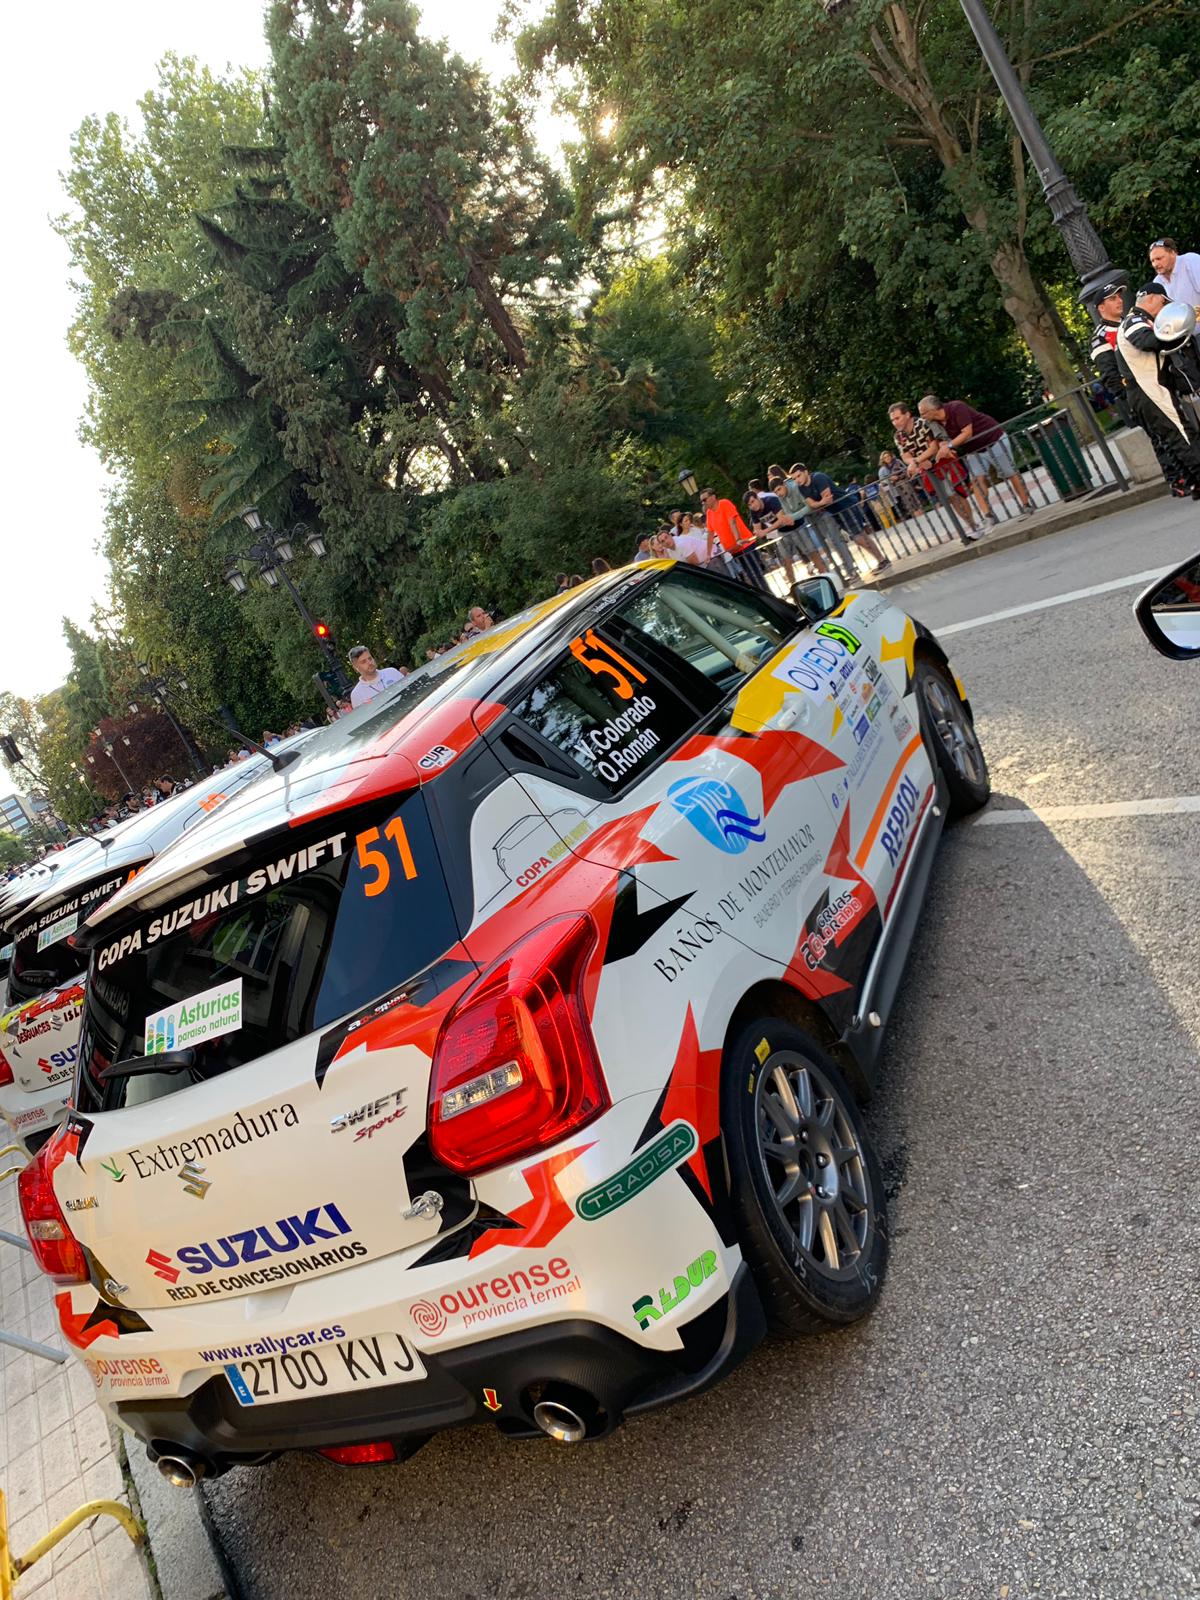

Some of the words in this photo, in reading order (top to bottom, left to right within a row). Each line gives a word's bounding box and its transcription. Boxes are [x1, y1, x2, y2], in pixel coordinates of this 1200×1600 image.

[569, 628, 648, 700] 51
[787, 638, 846, 691] OVIEDO
[815, 622, 862, 656] 51
[597, 728, 661, 782] O.Román
[880, 773, 920, 868] REPSOL
[355, 815, 418, 897] 51
[514, 856, 553, 888] COPA
[39, 898, 79, 928] SUZUKI
[80, 877, 123, 905] SWIFT
[97, 929, 142, 971] COPA
[146, 880, 239, 944] SUZUKI
[245, 831, 347, 894] SWIFT
[652, 911, 722, 983] BAÑOS
[717, 890, 745, 921] DE
[738, 823, 816, 903] MONTEMAYOR
[178, 990, 241, 1029] Asturias
[208, 1010, 241, 1031] natural
[46, 1072, 61, 1084] RED
[60, 1068, 71, 1079] DE
[330, 1086, 409, 1134] SWIFT
[352, 1105, 409, 1143] Sport
[127, 1103, 300, 1180] Extremadura
[586, 1136, 687, 1209] TRADISA
[176, 1201, 353, 1275] SUZUKI
[166, 1286, 198, 1302] RED
[197, 1281, 221, 1296] DE
[218, 1241, 368, 1292] CONCESIONARIOS
[439, 1257, 571, 1314] ourense
[462, 1297, 529, 1329] provincia
[529, 1275, 582, 1305] termal
[96, 1357, 163, 1376] ourense
[198, 1324, 347, 1363] www.rallycar.es
[241, 1350, 329, 1397] 2700
[336, 1333, 415, 1381] KVJ
[109, 1374, 144, 1390] provincia
[143, 1373, 171, 1387] termal
